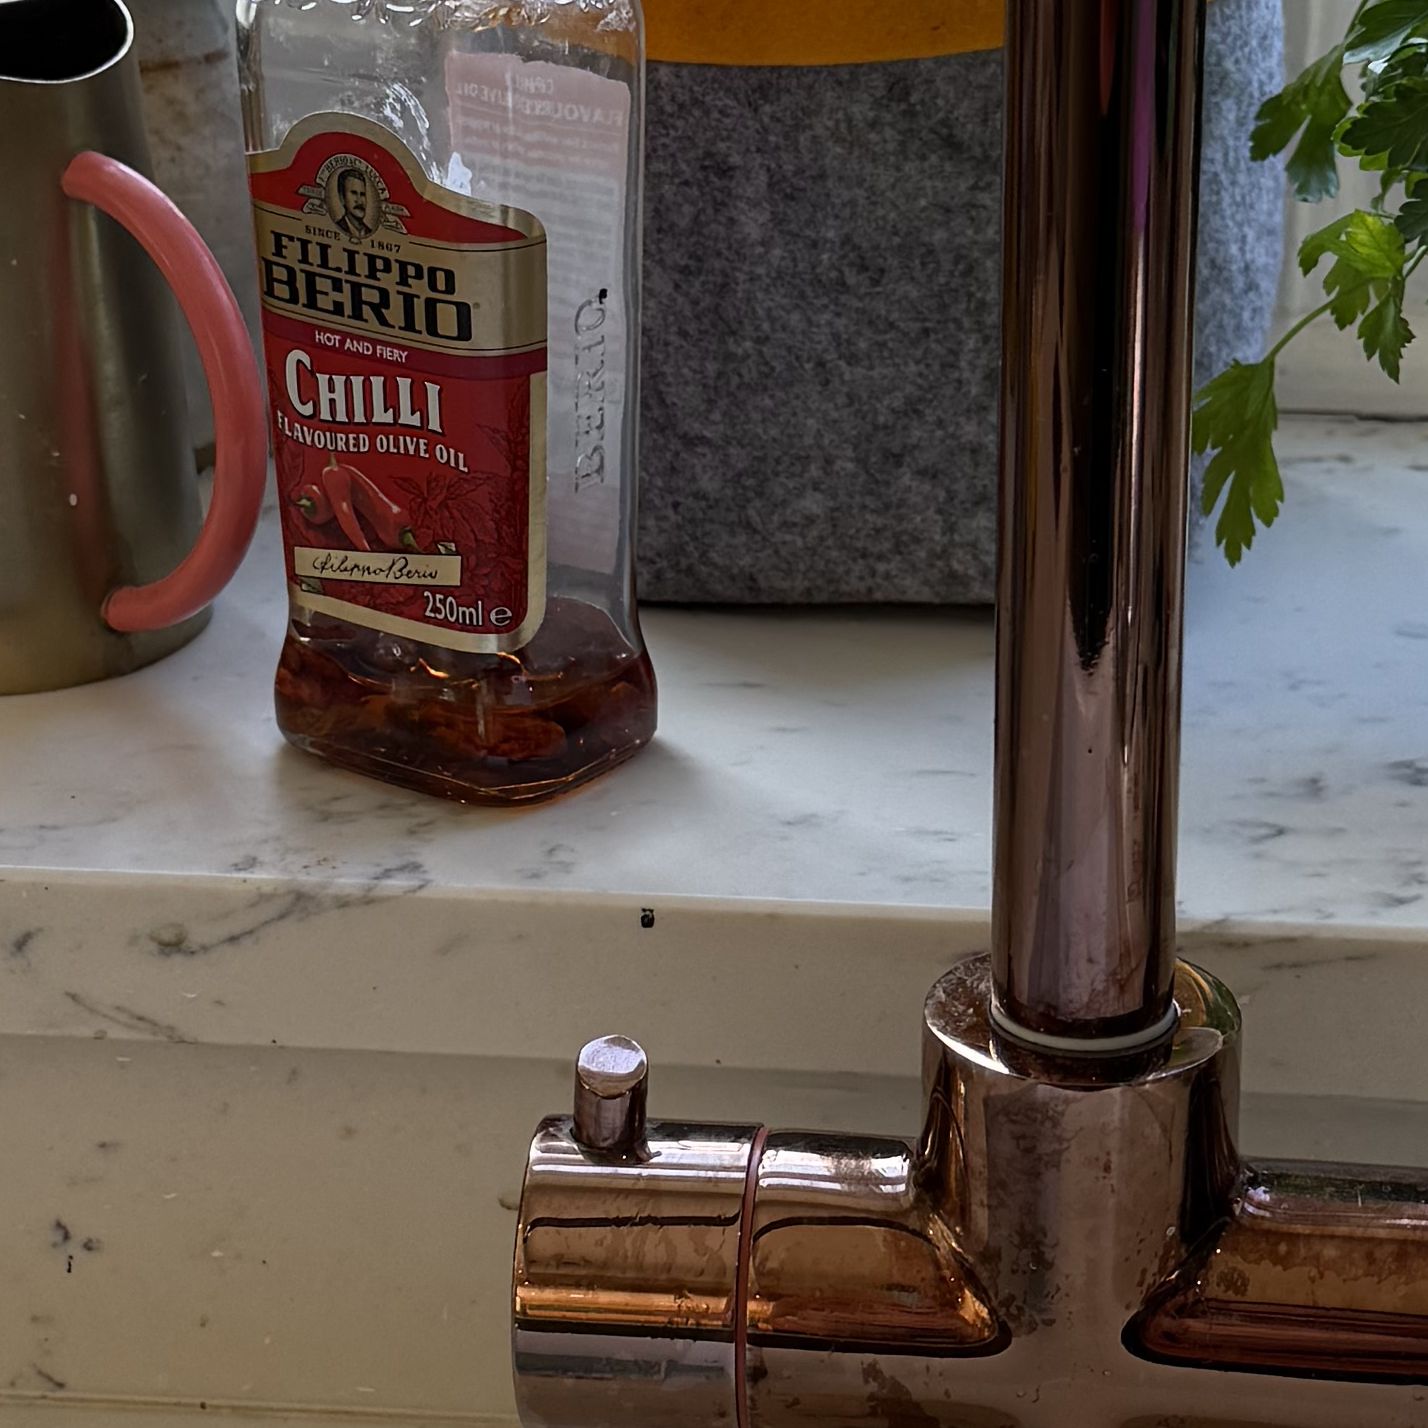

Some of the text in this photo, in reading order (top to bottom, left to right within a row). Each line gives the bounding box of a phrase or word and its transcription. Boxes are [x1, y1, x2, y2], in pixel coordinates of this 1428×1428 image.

[270, 229, 456, 296] FILIPPO
[305, 224, 341, 241] SINCE
[261, 255, 472, 343] BERIO
[315, 330, 409, 363] HOT AND FIERY
[285, 349, 444, 434] CHILLI
[277, 410, 469, 473] FLAVOURED OLIVE OIL
[423, 590, 483, 627] 250ml
